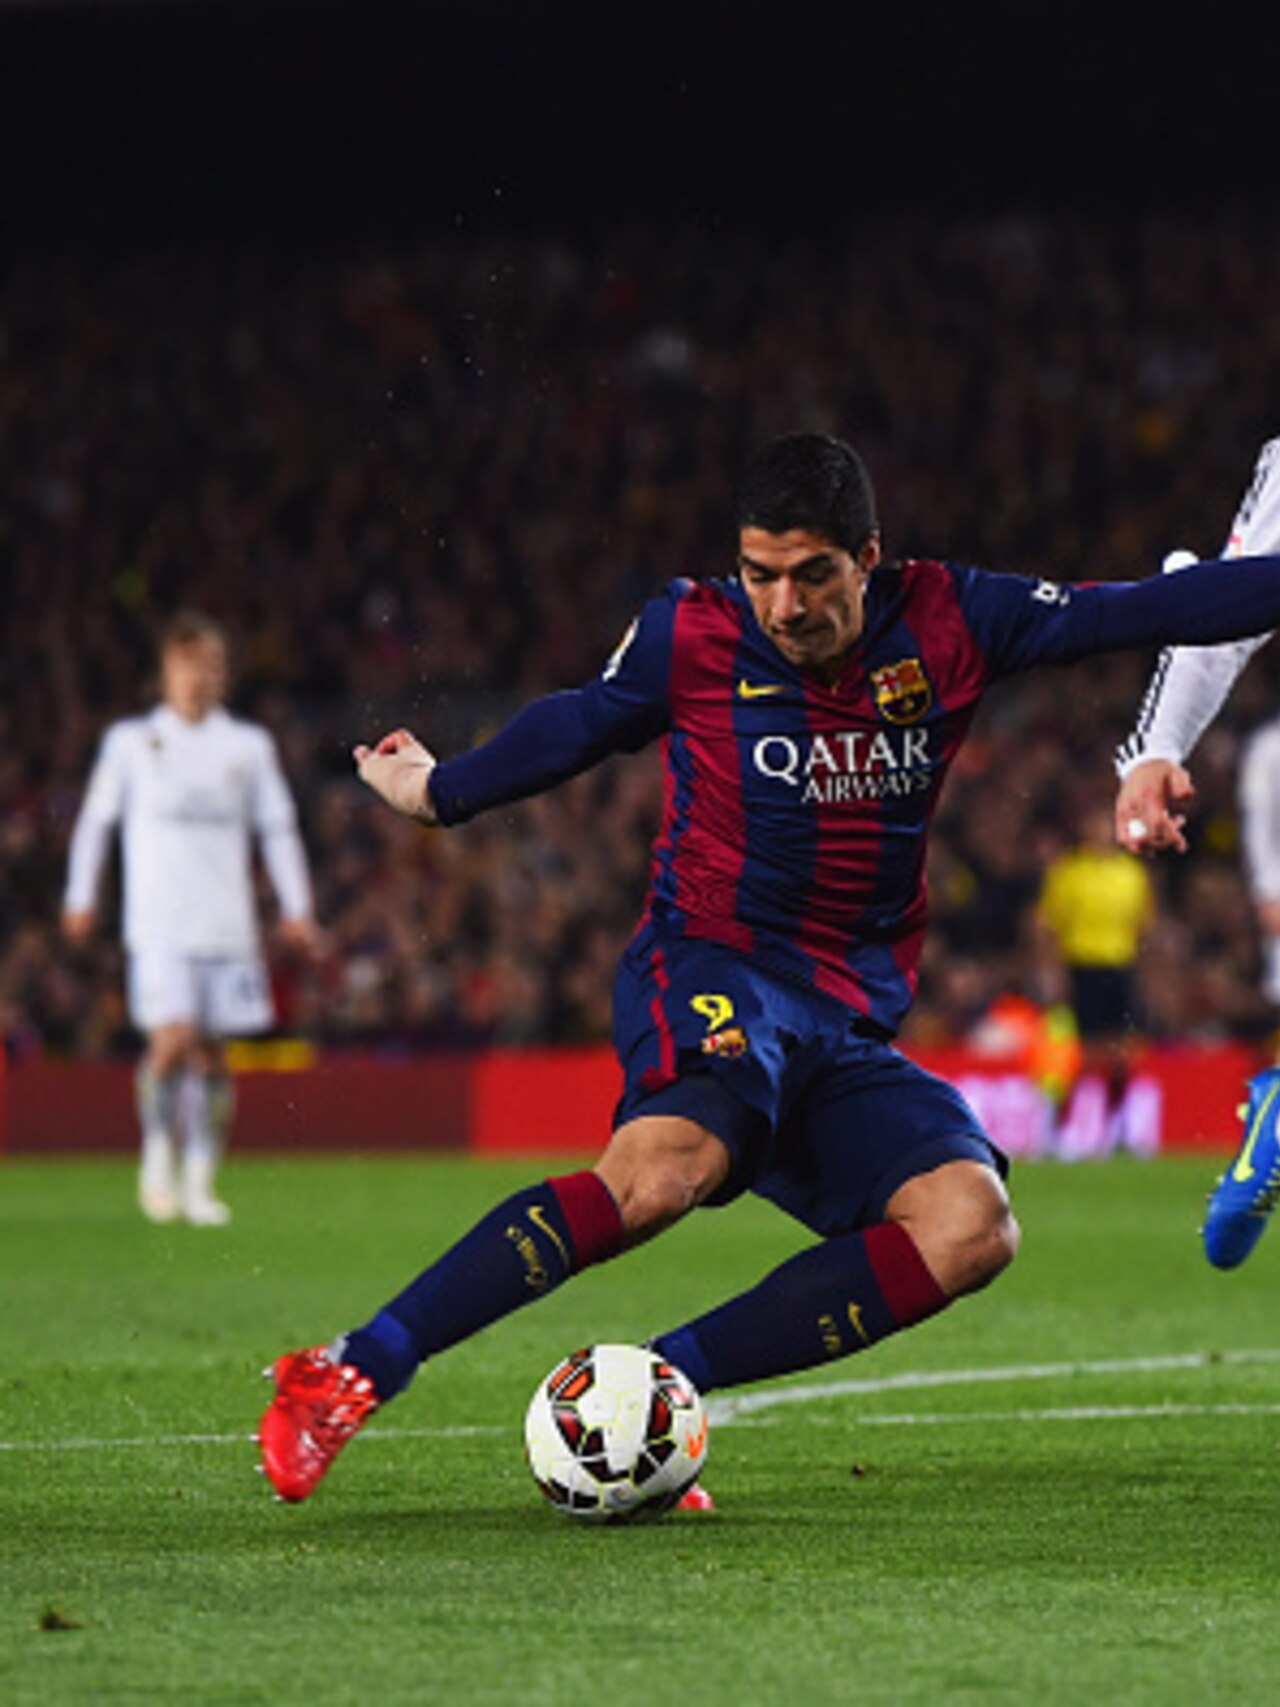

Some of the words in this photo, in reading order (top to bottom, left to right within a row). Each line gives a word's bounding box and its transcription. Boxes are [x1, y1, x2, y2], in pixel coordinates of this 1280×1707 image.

[753, 728, 930, 785] QATAR
[801, 767, 931, 803] AIRWAYS
[690, 994, 734, 1031] 9
